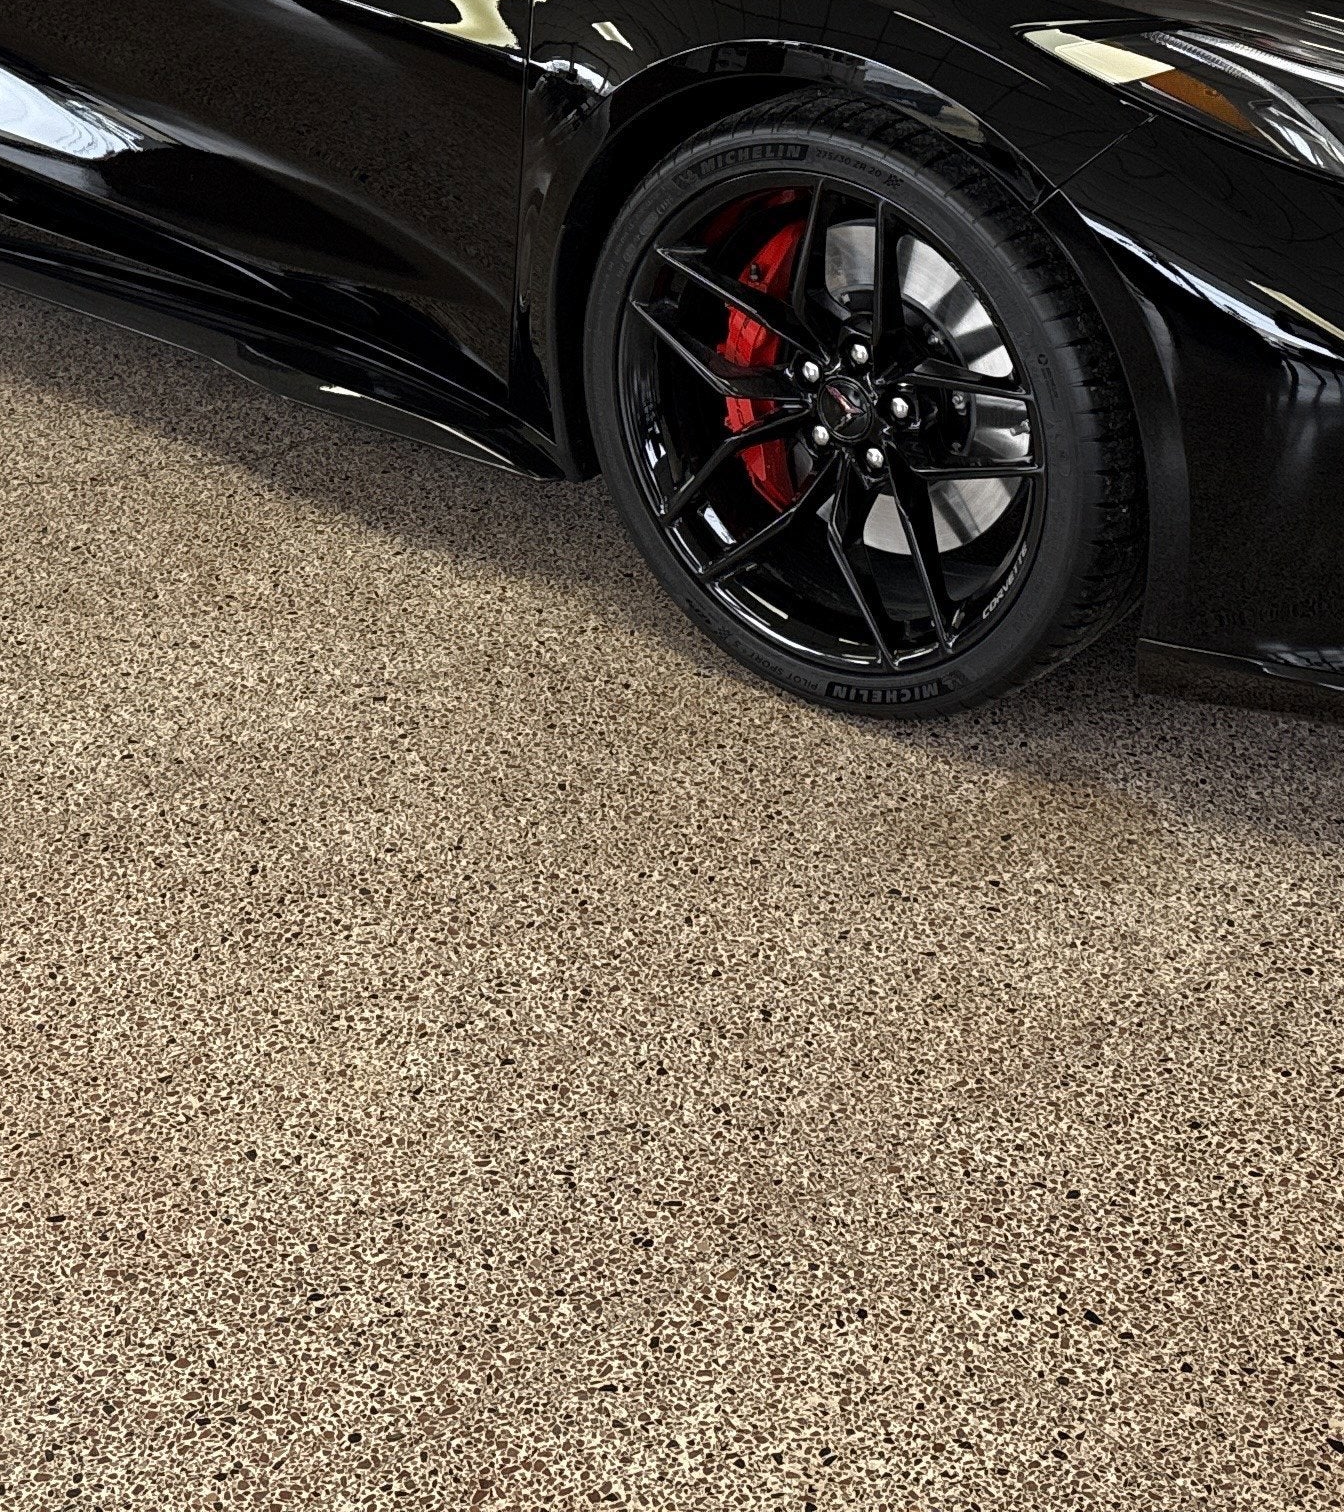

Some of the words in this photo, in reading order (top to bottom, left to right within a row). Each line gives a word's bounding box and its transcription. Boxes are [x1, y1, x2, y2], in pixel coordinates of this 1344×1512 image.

[700, 144, 802, 175] MICHELIN
[815, 148, 851, 165] 275/30
[853, 159, 866, 170] ZR
[867, 166, 882, 178] 20
[982, 541, 1027, 619] CORVETTE
[751, 650, 786, 673] SPORT
[788, 673, 819, 689] PILOT
[832, 679, 939, 704] MICHELIN
